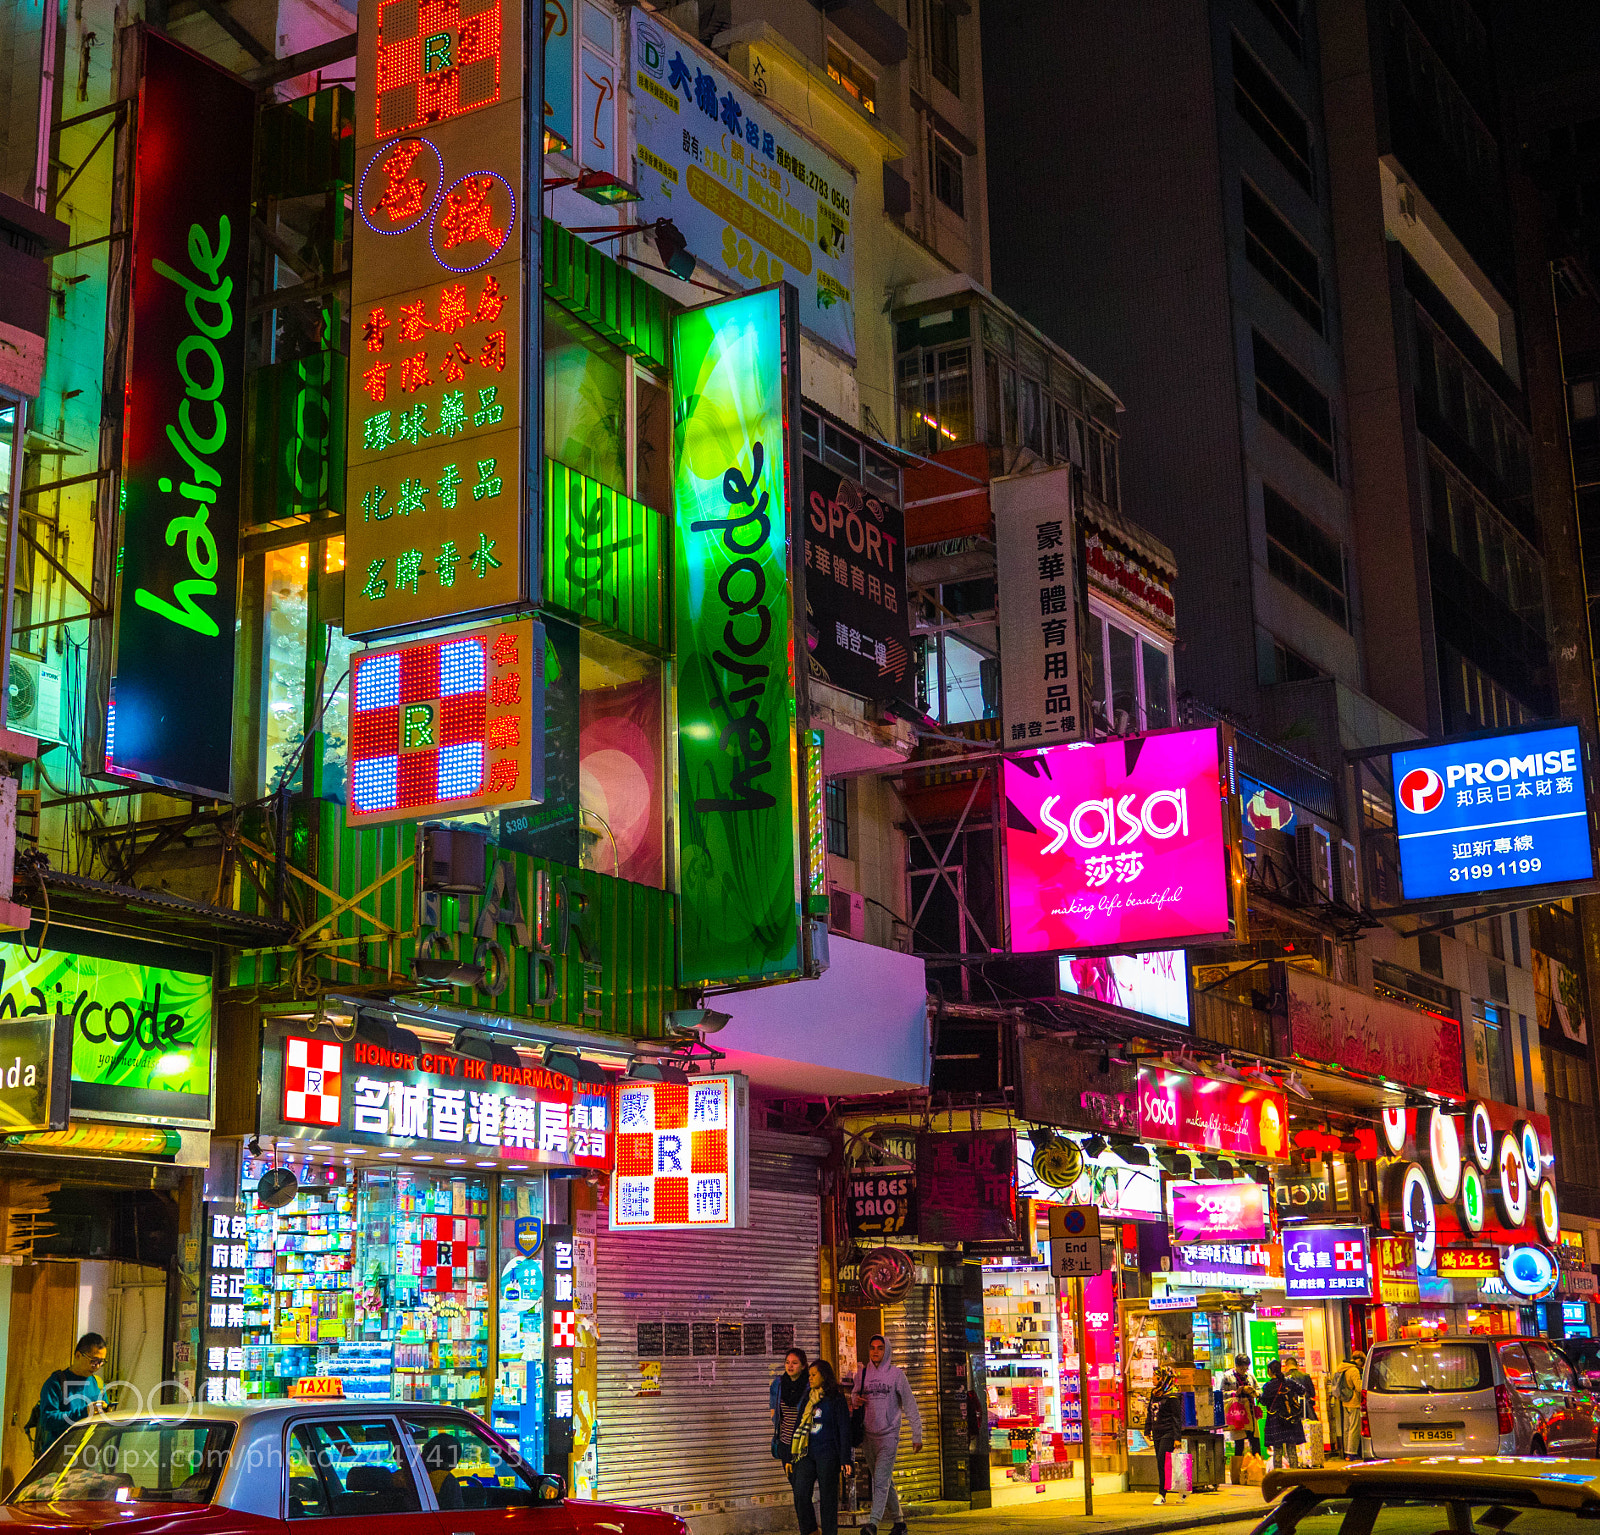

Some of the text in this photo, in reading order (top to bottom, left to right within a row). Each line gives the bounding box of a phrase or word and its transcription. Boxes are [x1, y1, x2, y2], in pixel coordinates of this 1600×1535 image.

[831, 188, 850, 216] 0543
[362, 275, 509, 352] 香港藥房
[363, 330, 506, 402] 有限公司
[135, 214, 234, 637] haircode
[363, 386, 504, 450] 環球藥品
[361, 458, 503, 522] 化妝香品
[810, 491, 897, 572] SPORT
[359, 533, 503, 601] 名牌香水
[1036, 520, 1072, 715] 豪華體育用品
[835, 621, 887, 668] 請登二樓
[487, 633, 521, 793] 名城藥房
[1011, 716, 1076, 740] 請登二樓
[1446, 749, 1577, 788] PROMISE
[1456, 776, 1574, 808] 邦民日本財務
[506, 816, 528, 835] $380
[1453, 835, 1535, 860] 迎新專線
[1085, 851, 1145, 887] 莎莎
[1449, 857, 1542, 882] 3199 1199
[1051, 886, 1183, 920] making life beautiful
[355, 1043, 415, 1070] HONOR
[422, 1053, 458, 1076] CITY
[464, 1059, 486, 1080] HK
[492, 1063, 573, 1093] PHARMACY
[354, 1076, 570, 1153] 名城香港藥房
[575, 1130, 606, 1157] 公司
[1061, 1257, 1092, 1272] 終止
[1065, 1241, 1088, 1253] End
[1298, 1252, 1333, 1270] 藥皇
[210, 1214, 230, 1328] 政府註冊
[299, 1379, 331, 1394] TAXI
[1412, 1430, 1453, 1440] TR 9436
